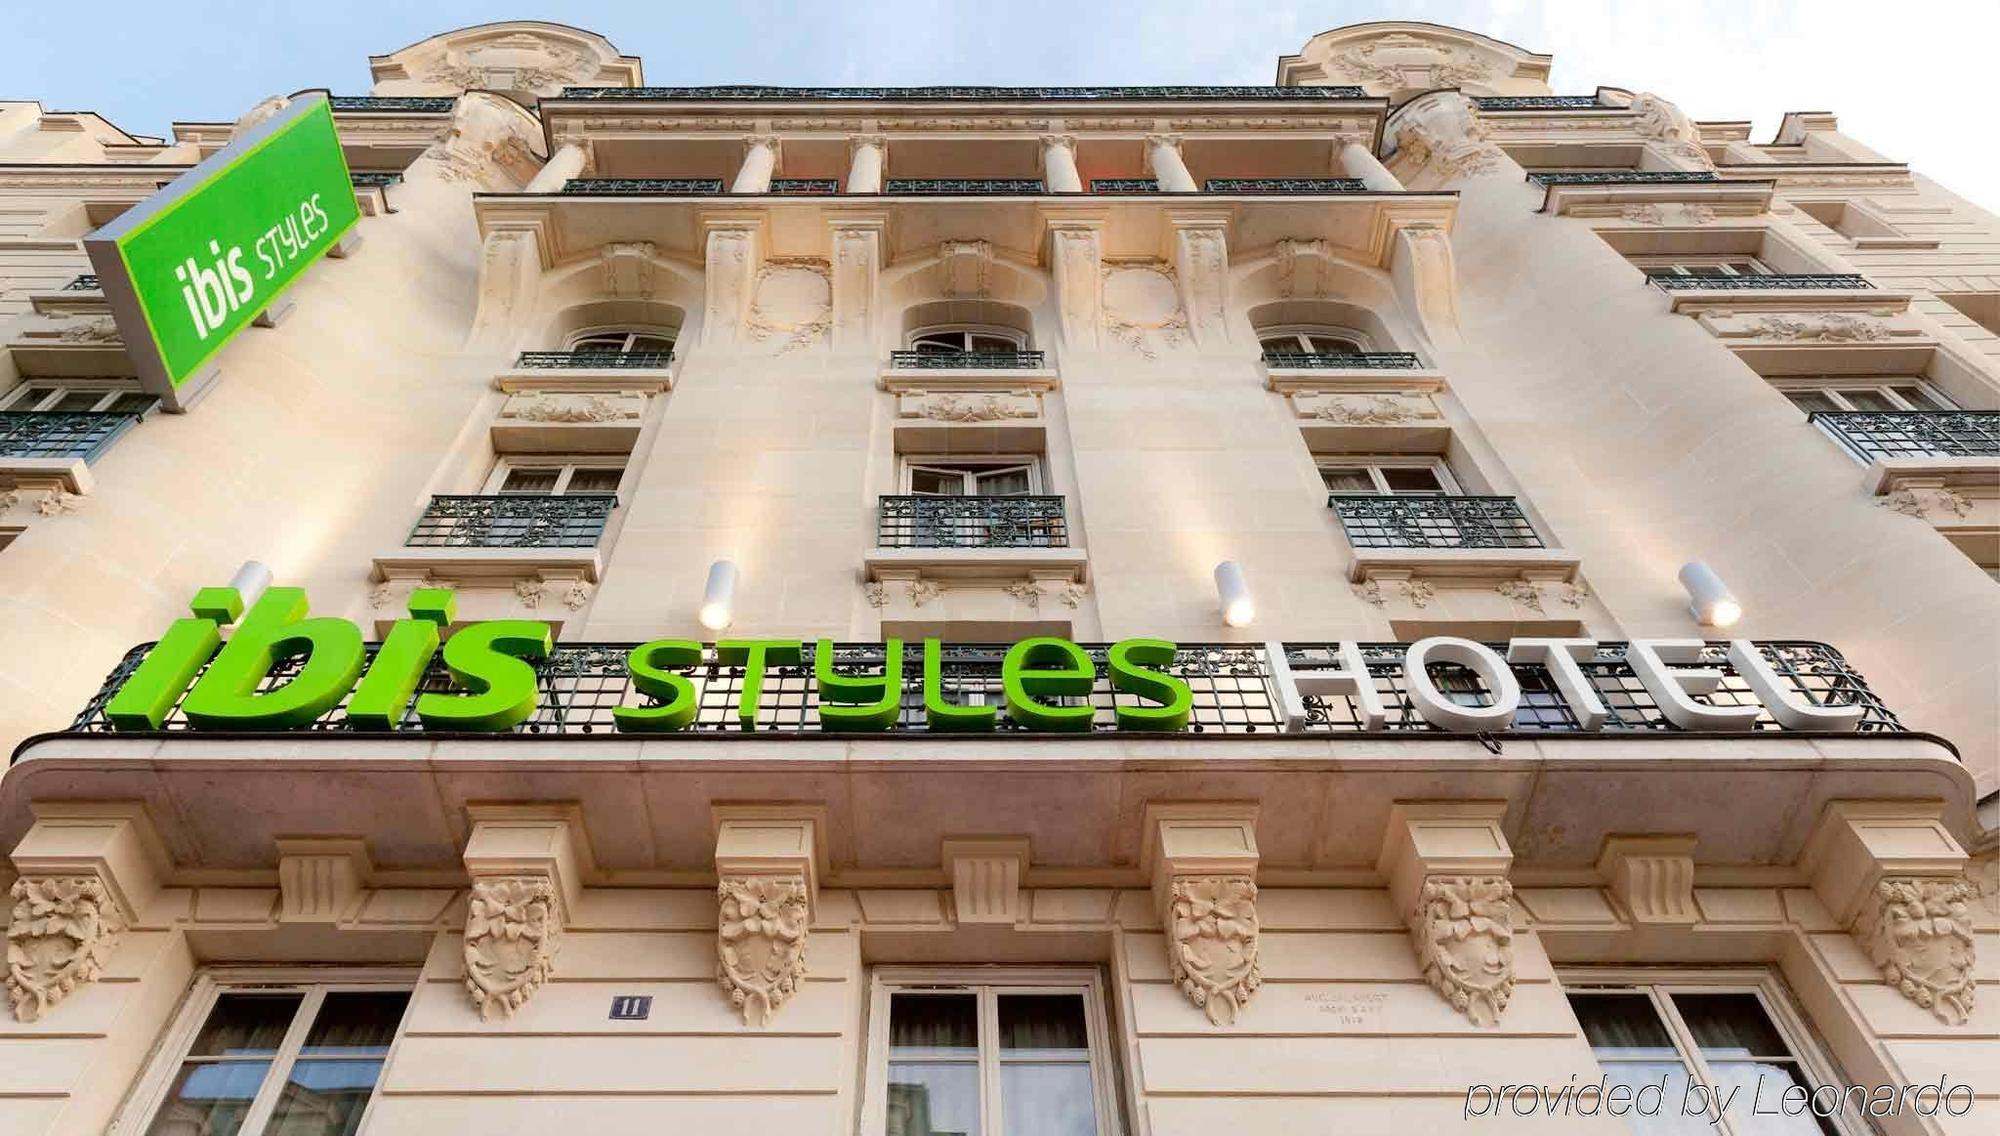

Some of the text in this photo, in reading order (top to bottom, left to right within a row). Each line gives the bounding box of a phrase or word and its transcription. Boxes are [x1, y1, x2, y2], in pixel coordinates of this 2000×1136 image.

[175, 239, 254, 340] ibis
[106, 587, 552, 732] ibis
[1265, 636, 1865, 732] HOTEL
[621, 998, 641, 1016] 11
